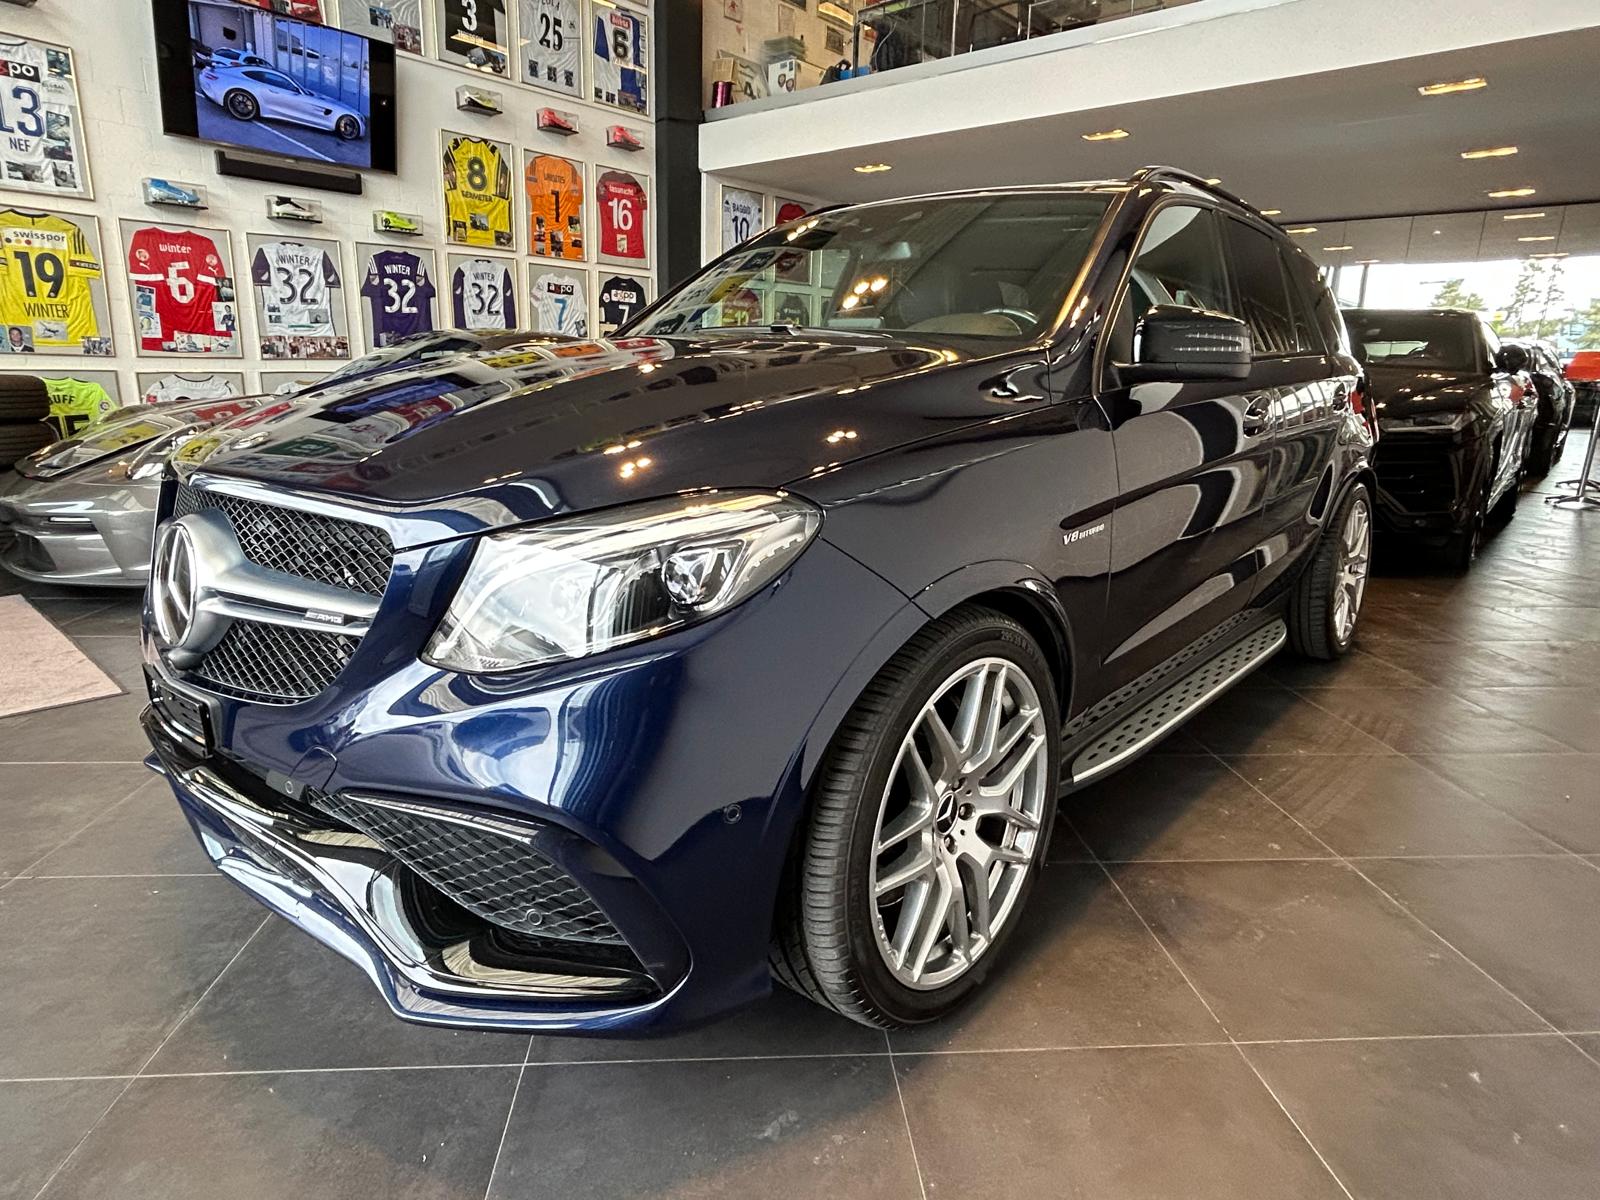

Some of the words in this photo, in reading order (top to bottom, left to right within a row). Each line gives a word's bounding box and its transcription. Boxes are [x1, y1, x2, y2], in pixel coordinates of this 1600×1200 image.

[461, 0, 477, 31] 3
[539, 12, 562, 51] 25
[613, 28, 628, 59] 6
[9, 136, 31, 152] NEF
[467, 156, 487, 191] 8
[550, 189, 560, 223] 1
[607, 197, 633, 231] 16
[732, 215, 750, 243] 10
[13, 250, 64, 298] 19
[278, 254, 311, 266] WINTER
[384, 264, 411, 276] WINTER
[166, 261, 195, 304] 6
[277, 267, 319, 305] 32
[383, 277, 418, 314] 32
[23, 302, 70, 319] WINTER
[472, 283, 500, 315] 32
[554, 298, 567, 330] 7
[618, 304, 630, 324] 7
[1063, 530, 1079, 545] V8
